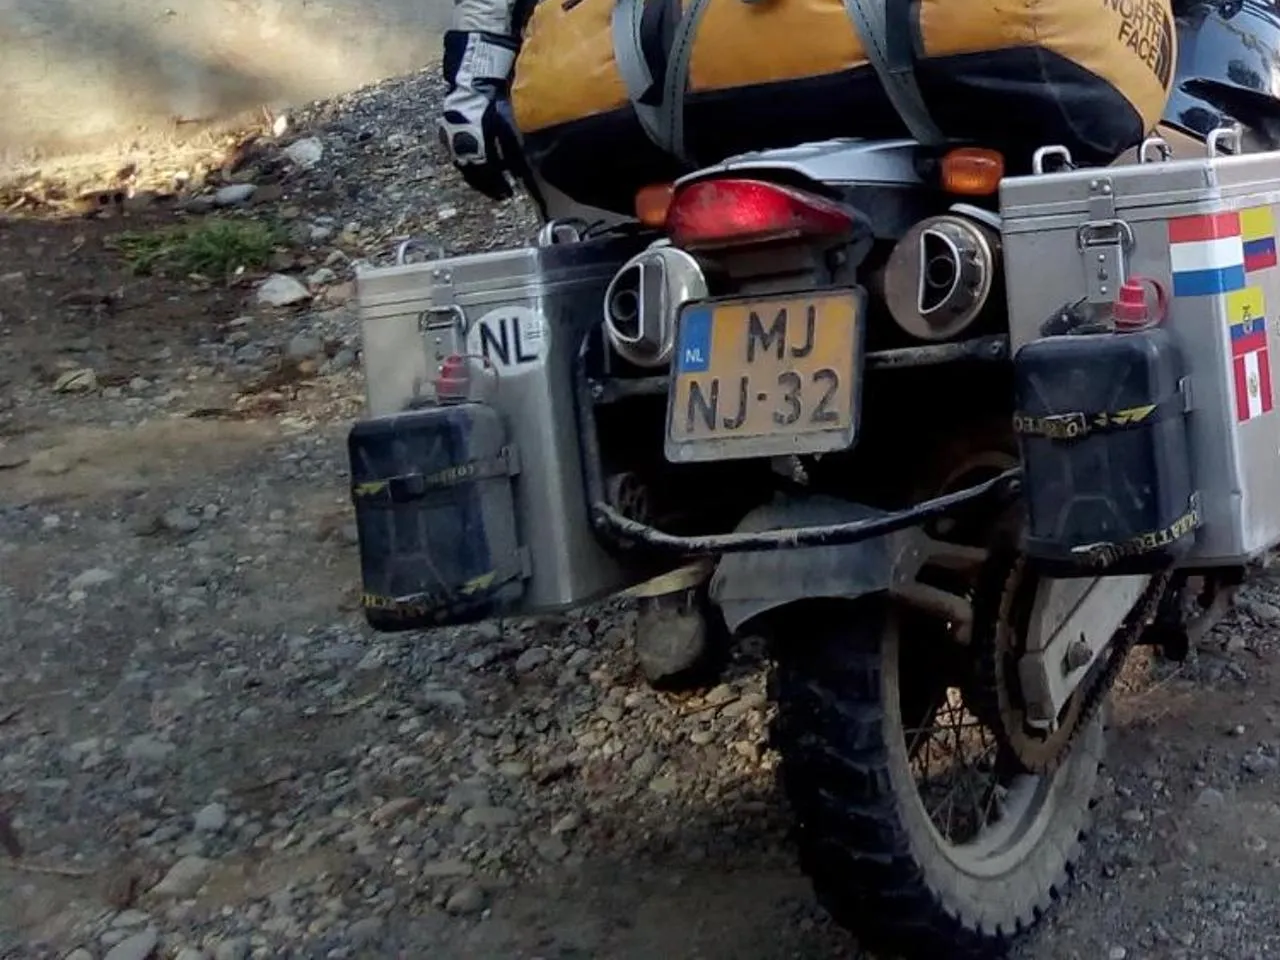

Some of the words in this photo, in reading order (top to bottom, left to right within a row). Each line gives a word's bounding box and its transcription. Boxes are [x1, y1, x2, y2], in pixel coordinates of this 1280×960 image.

[1118, 20, 1158, 69] FACE
[480, 317, 538, 367] NL
[686, 349, 704, 363] NL
[747, 304, 816, 363] MJ
[686, 368, 840, 433] NJ-32
